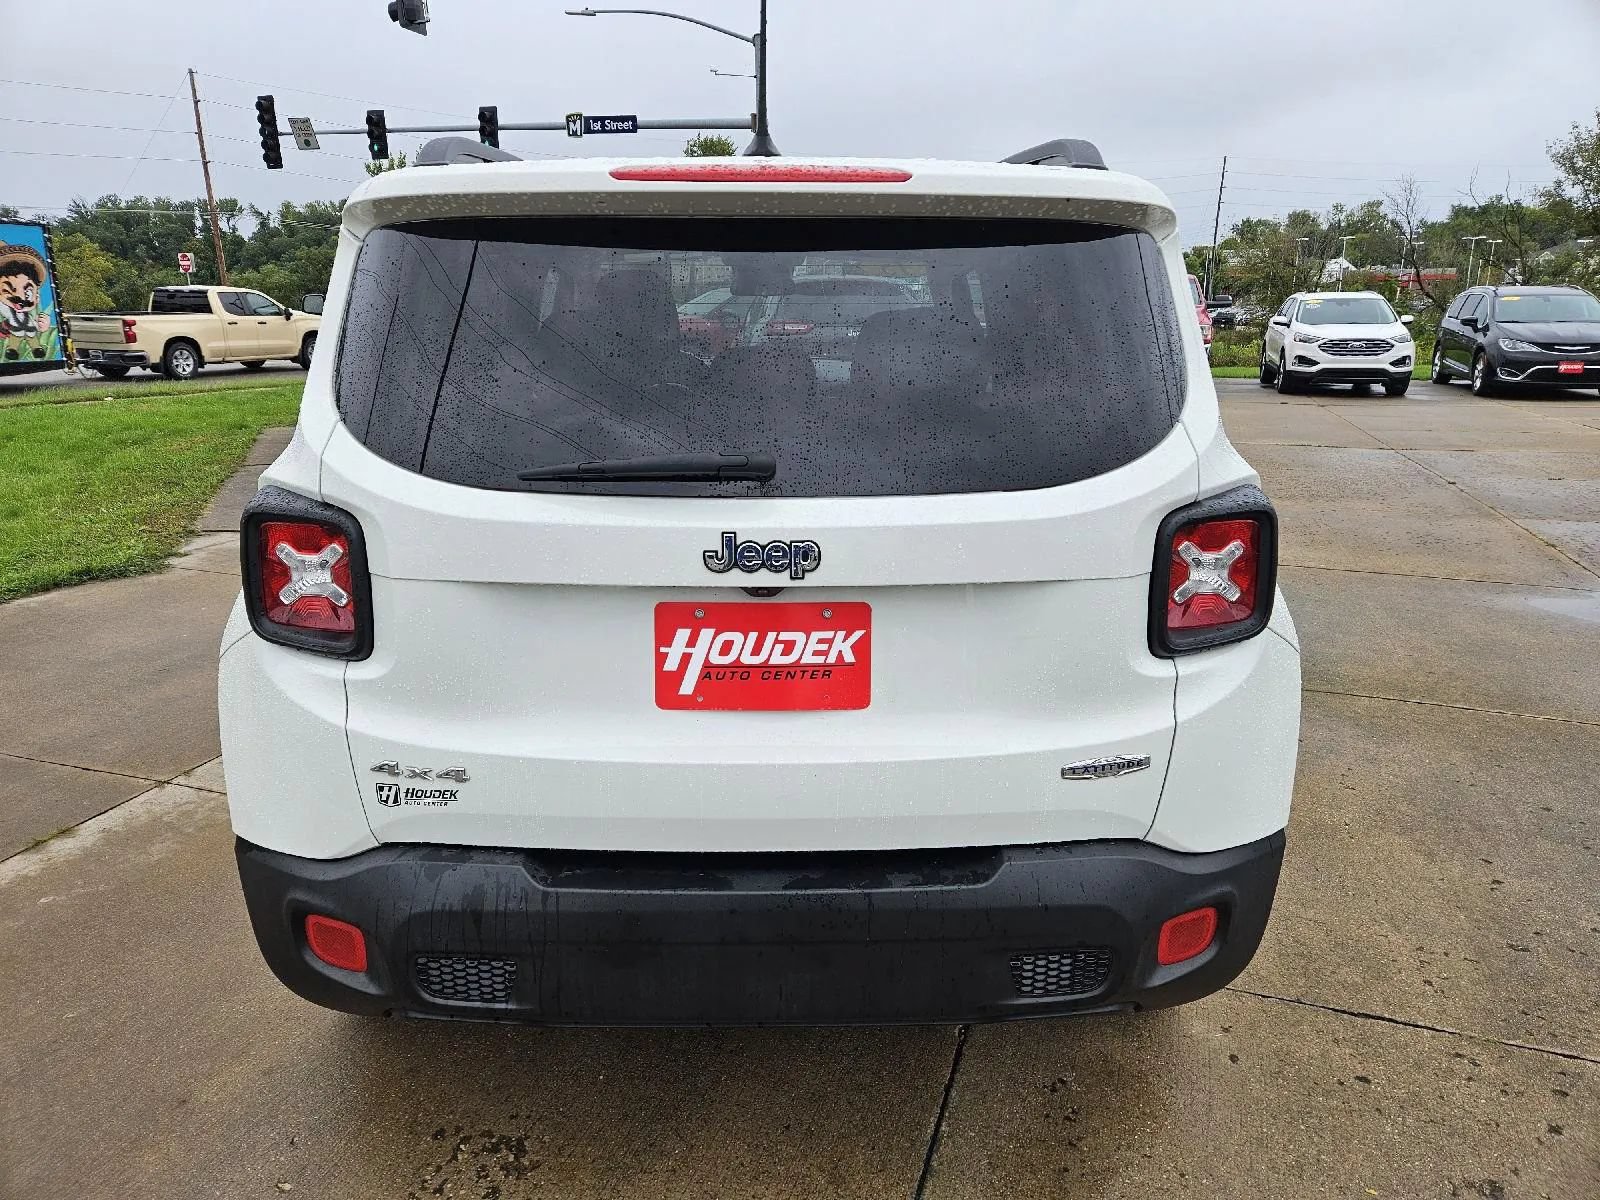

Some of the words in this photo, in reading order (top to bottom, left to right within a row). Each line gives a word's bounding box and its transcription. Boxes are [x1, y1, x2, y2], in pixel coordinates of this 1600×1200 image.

[589, 119, 602, 131] 1st
[604, 119, 633, 130] Street
[703, 531, 821, 580] Jeep
[659, 628, 866, 695] HOUDEK
[701, 670, 751, 681] AUTO
[760, 669, 833, 680] CENTER
[1072, 759, 1144, 775] LATITUDE
[403, 787, 459, 800] HOUDEK
